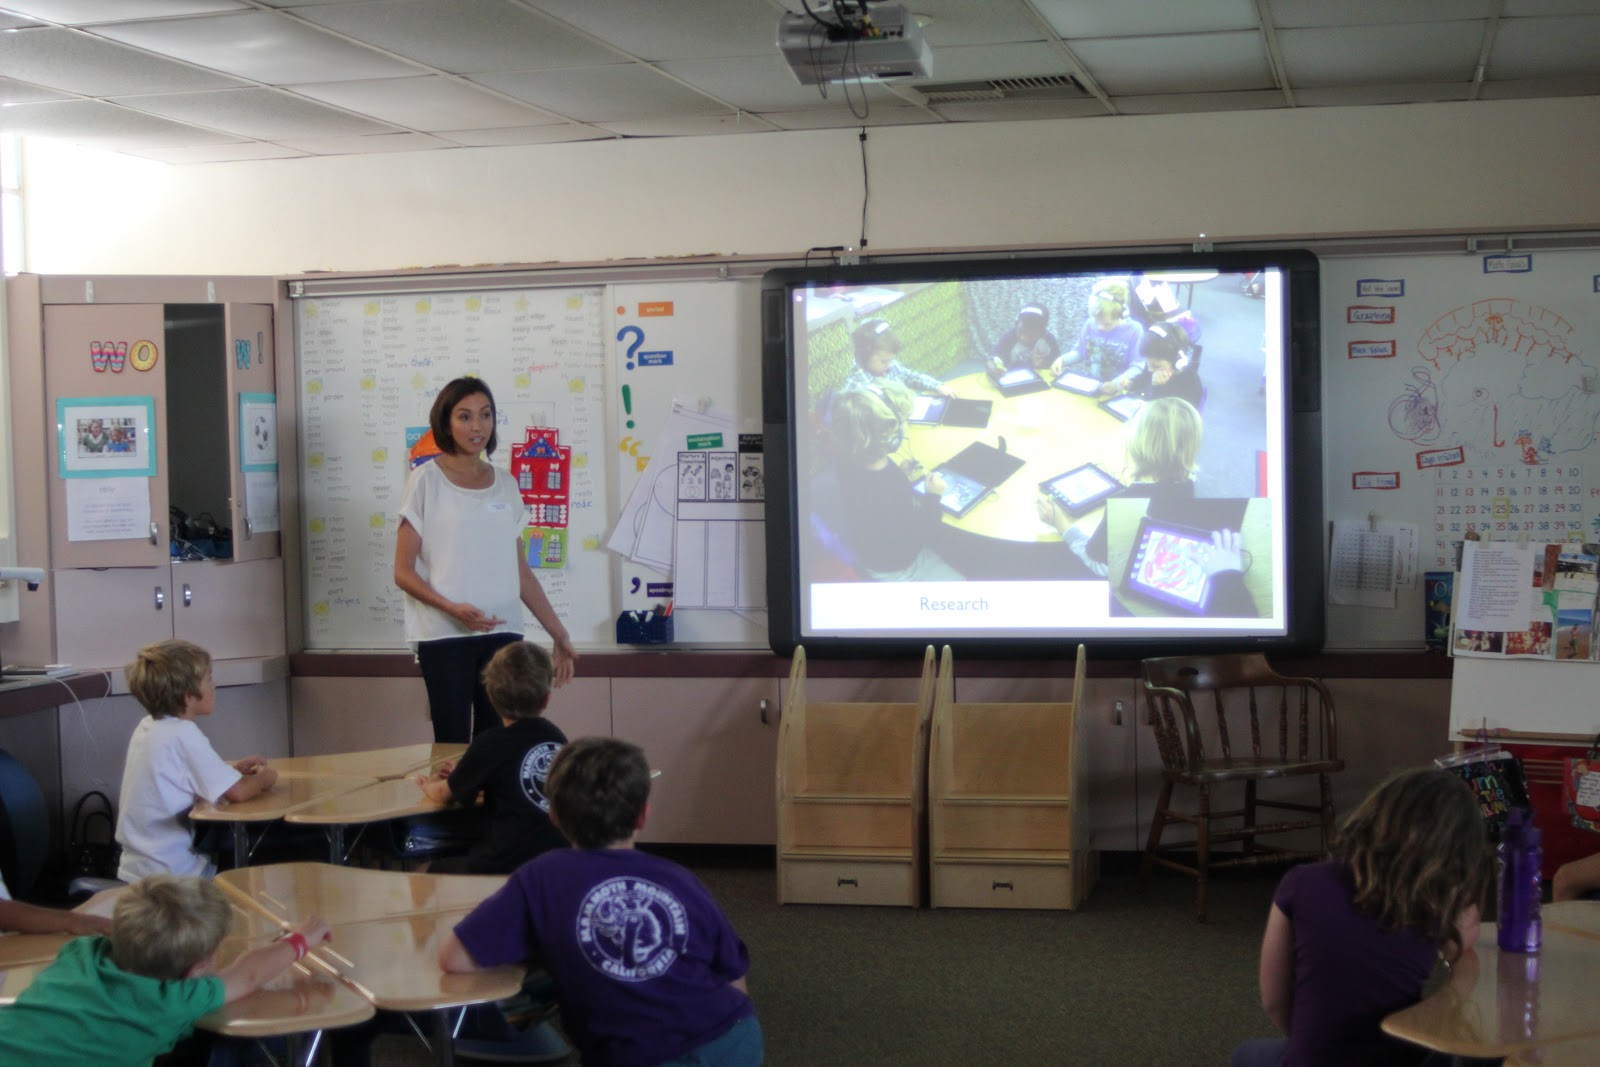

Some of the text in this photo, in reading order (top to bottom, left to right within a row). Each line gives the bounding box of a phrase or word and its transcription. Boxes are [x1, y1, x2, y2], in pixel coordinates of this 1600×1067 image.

[1452, 470, 1458, 479] 2
[1467, 470, 1473, 478] 3
[1482, 469, 1488, 478] 4
[1497, 469, 1503, 478] 5
[1510, 470, 1516, 478] 6
[1525, 469, 1531, 478] 7
[1540, 468, 1546, 477] 8
[1556, 468, 1562, 477] 9
[1569, 468, 1579, 477] 10
[1437, 488, 1443, 496] 11
[1451, 488, 1459, 496] 12
[1466, 488, 1474, 496] 13
[1481, 488, 1489, 496] 14
[1497, 487, 1504, 496] 15
[1510, 487, 1517, 496] 16
[1524, 486, 1532, 495] 17
[1538, 486, 1547, 495] 18
[1555, 486, 1563, 494] 19
[1568, 485, 1580, 494] 20
[1437, 503, 1581, 514] 21 22 23 24 25 26 27 28 29 30
[1436, 523, 1444, 531] 31
[1450, 523, 1460, 531] 32
[1480, 522, 1491, 531] 34
[1496, 522, 1505, 531] 35
[1508, 522, 1518, 531] 36
[1523, 522, 1533, 530] 37
[1538, 522, 1549, 530] 38
[1554, 521, 1565, 530] 39
[1568, 521, 1580, 529] 40
[1436, 558, 1445, 567] 51
[920, 596, 989, 611] Research
[523, 745, 549, 779] MAMMOTH
[580, 880, 686, 942] MAMMOTH MOUNTAIN
[601, 948, 676, 978] CALIFORNIA
